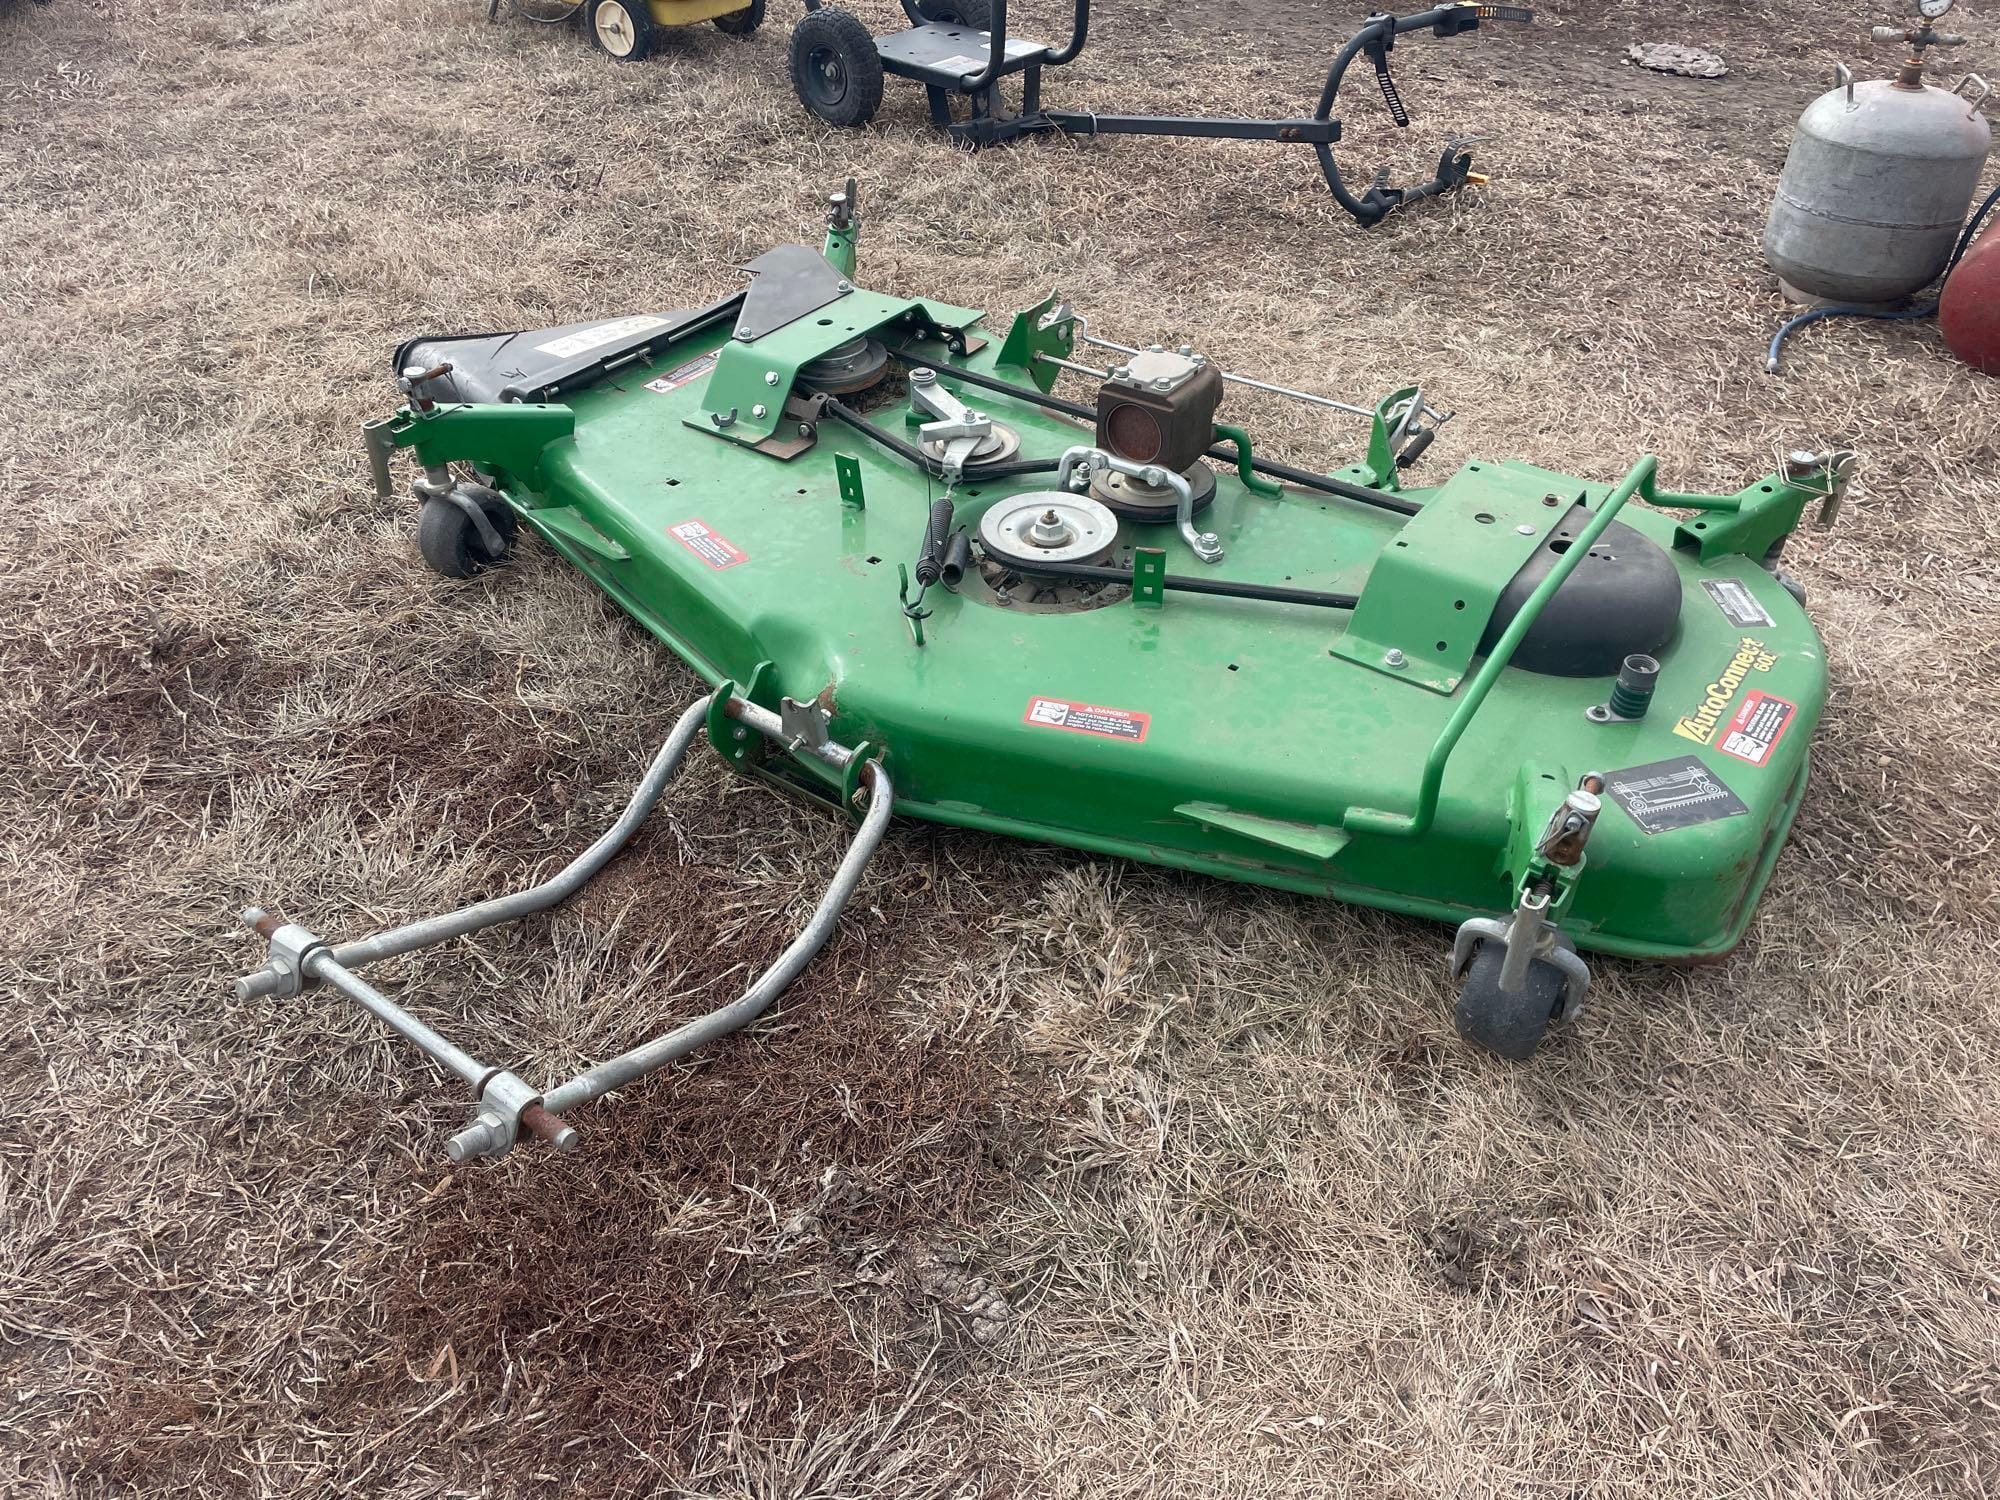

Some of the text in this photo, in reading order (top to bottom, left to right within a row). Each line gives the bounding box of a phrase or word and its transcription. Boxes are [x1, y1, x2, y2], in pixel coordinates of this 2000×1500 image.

[1681, 637, 1764, 742] AutoConnect
[1076, 712, 1108, 720] ROTATING
[1095, 708, 1129, 717] DANGER
